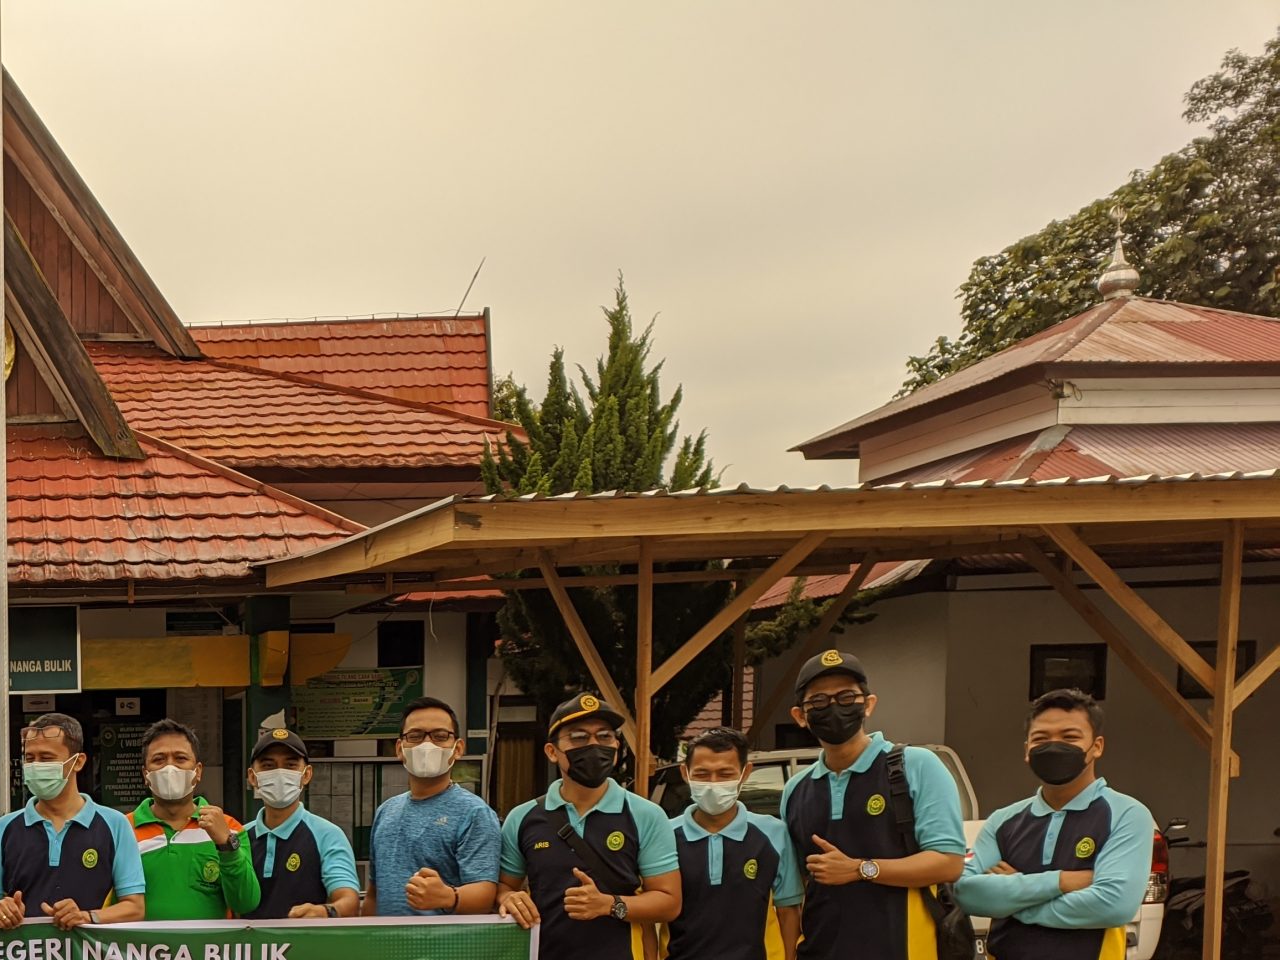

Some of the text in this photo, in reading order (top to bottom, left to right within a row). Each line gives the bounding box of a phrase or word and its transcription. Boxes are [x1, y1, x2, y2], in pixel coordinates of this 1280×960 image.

[9, 660, 42, 673] NANGA
[44, 659, 72, 672] BULIK
[533, 841, 550, 850] ARIS
